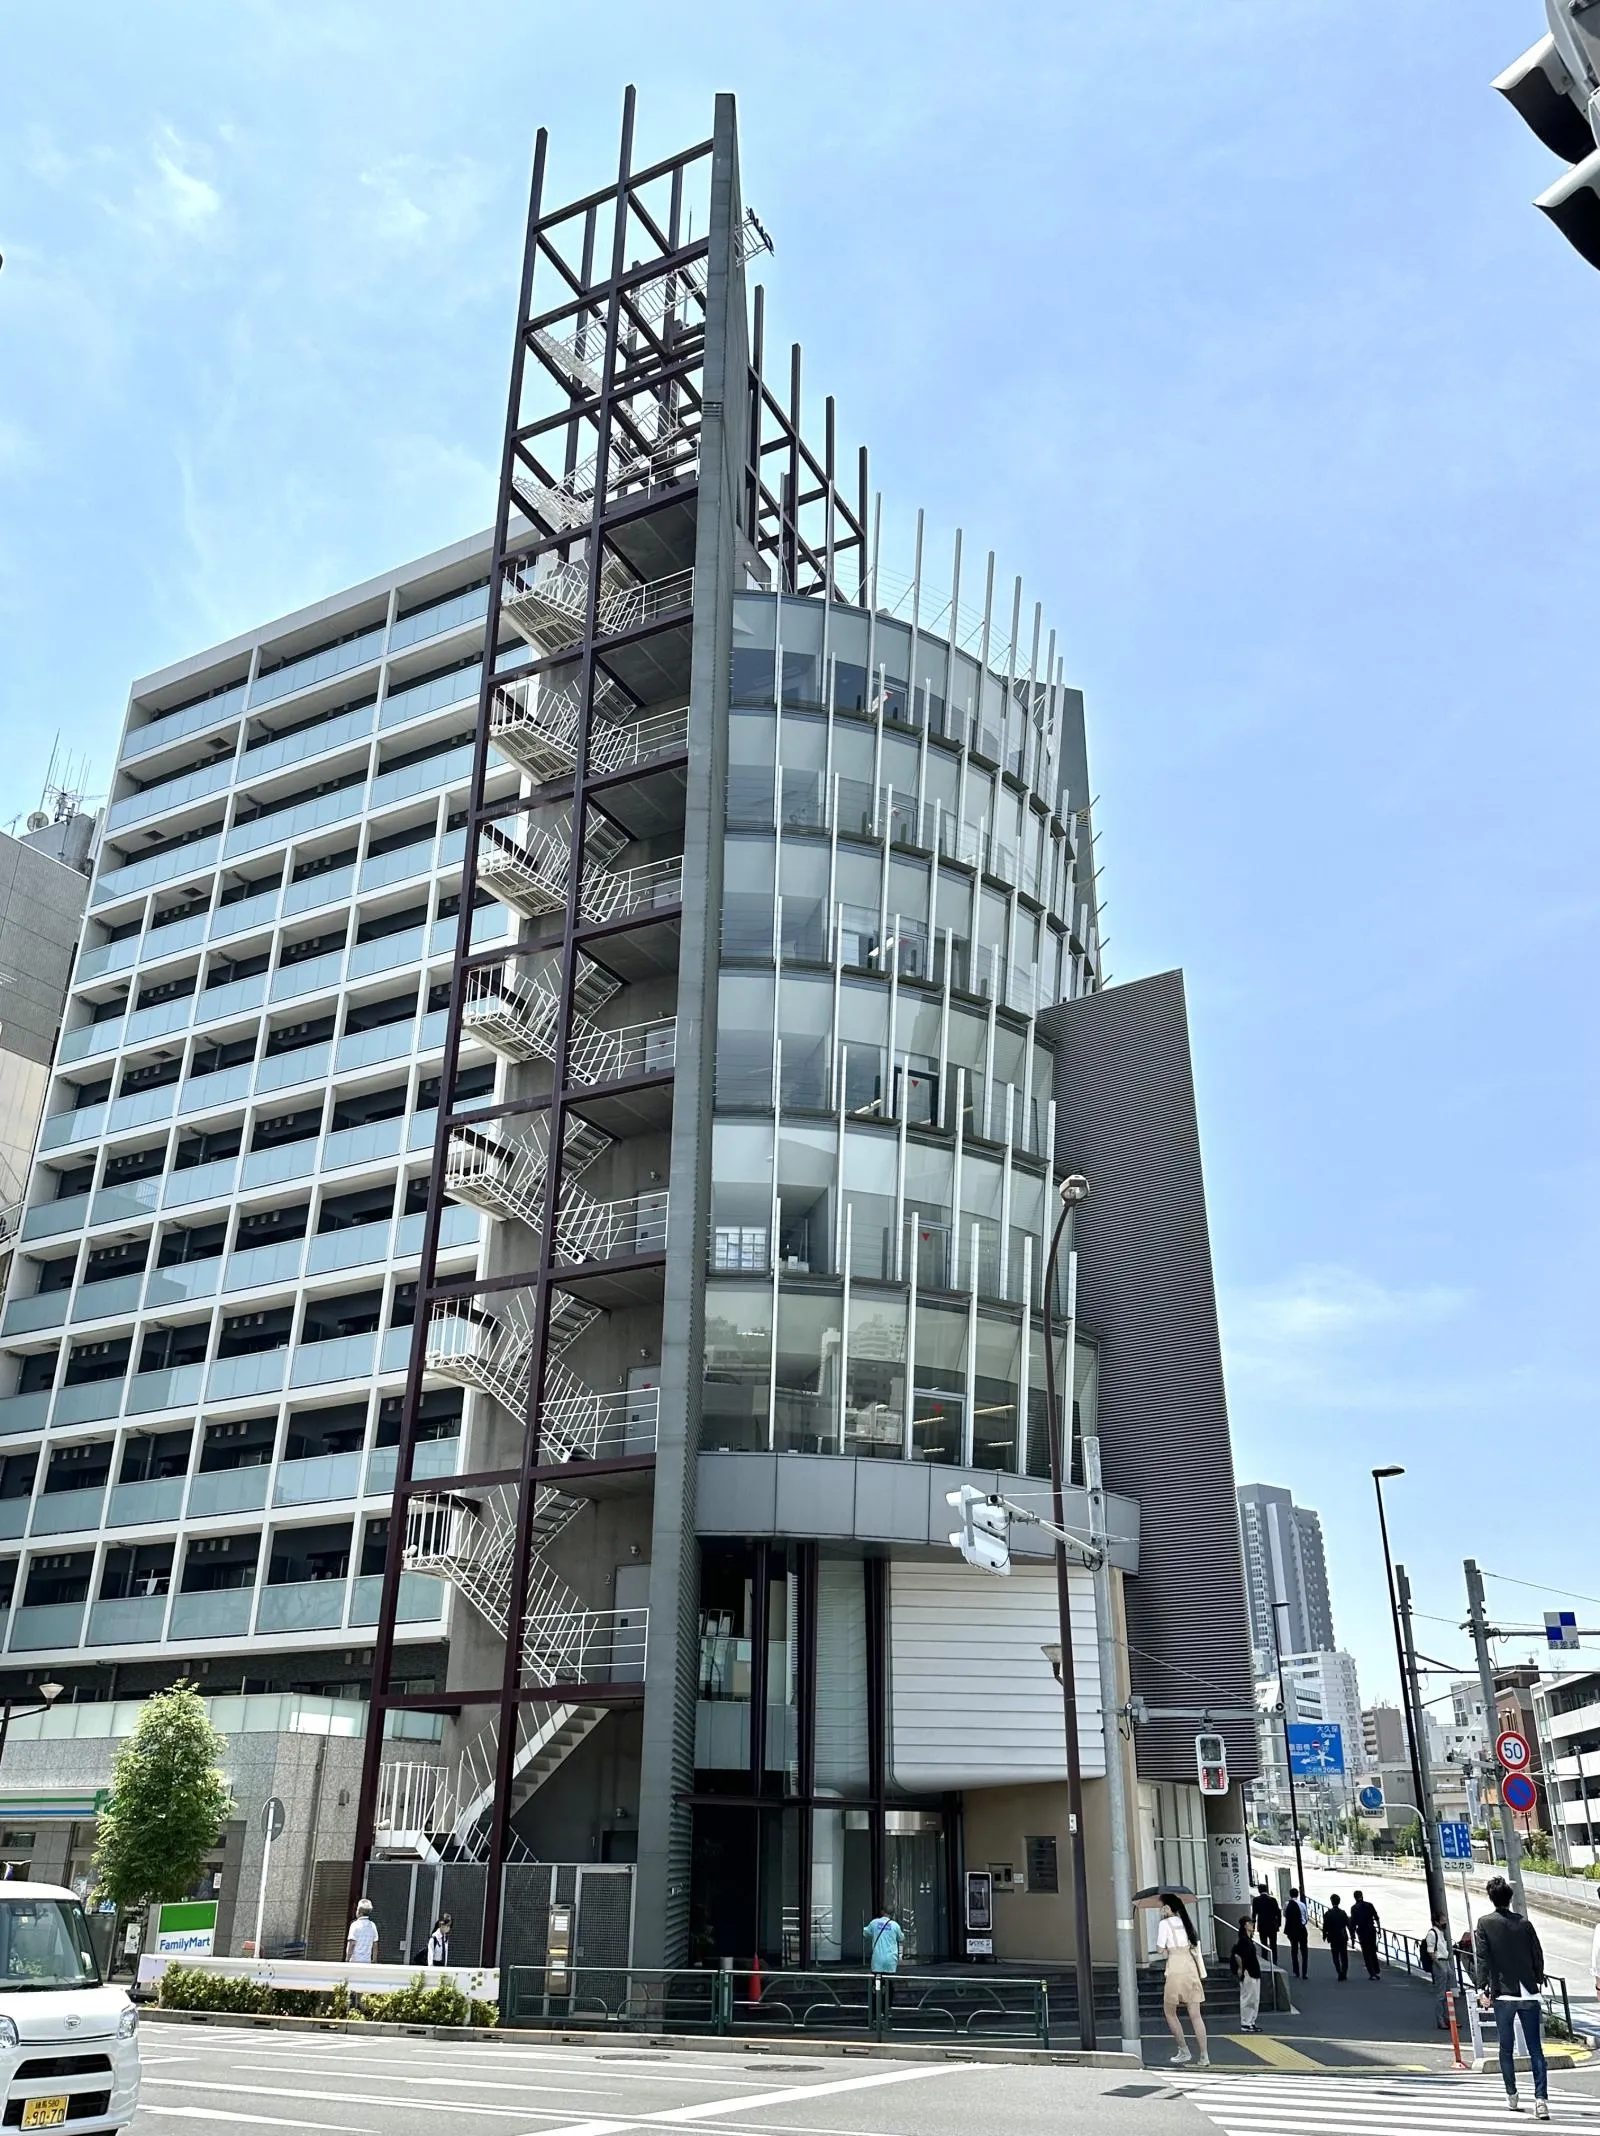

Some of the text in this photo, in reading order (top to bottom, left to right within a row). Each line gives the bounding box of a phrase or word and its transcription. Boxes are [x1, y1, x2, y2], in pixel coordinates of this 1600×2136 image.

[1504, 1742, 1523, 1759] 50
[1444, 1861, 1472, 1870] ここから
[159, 1936, 211, 1951] FamilyMart
